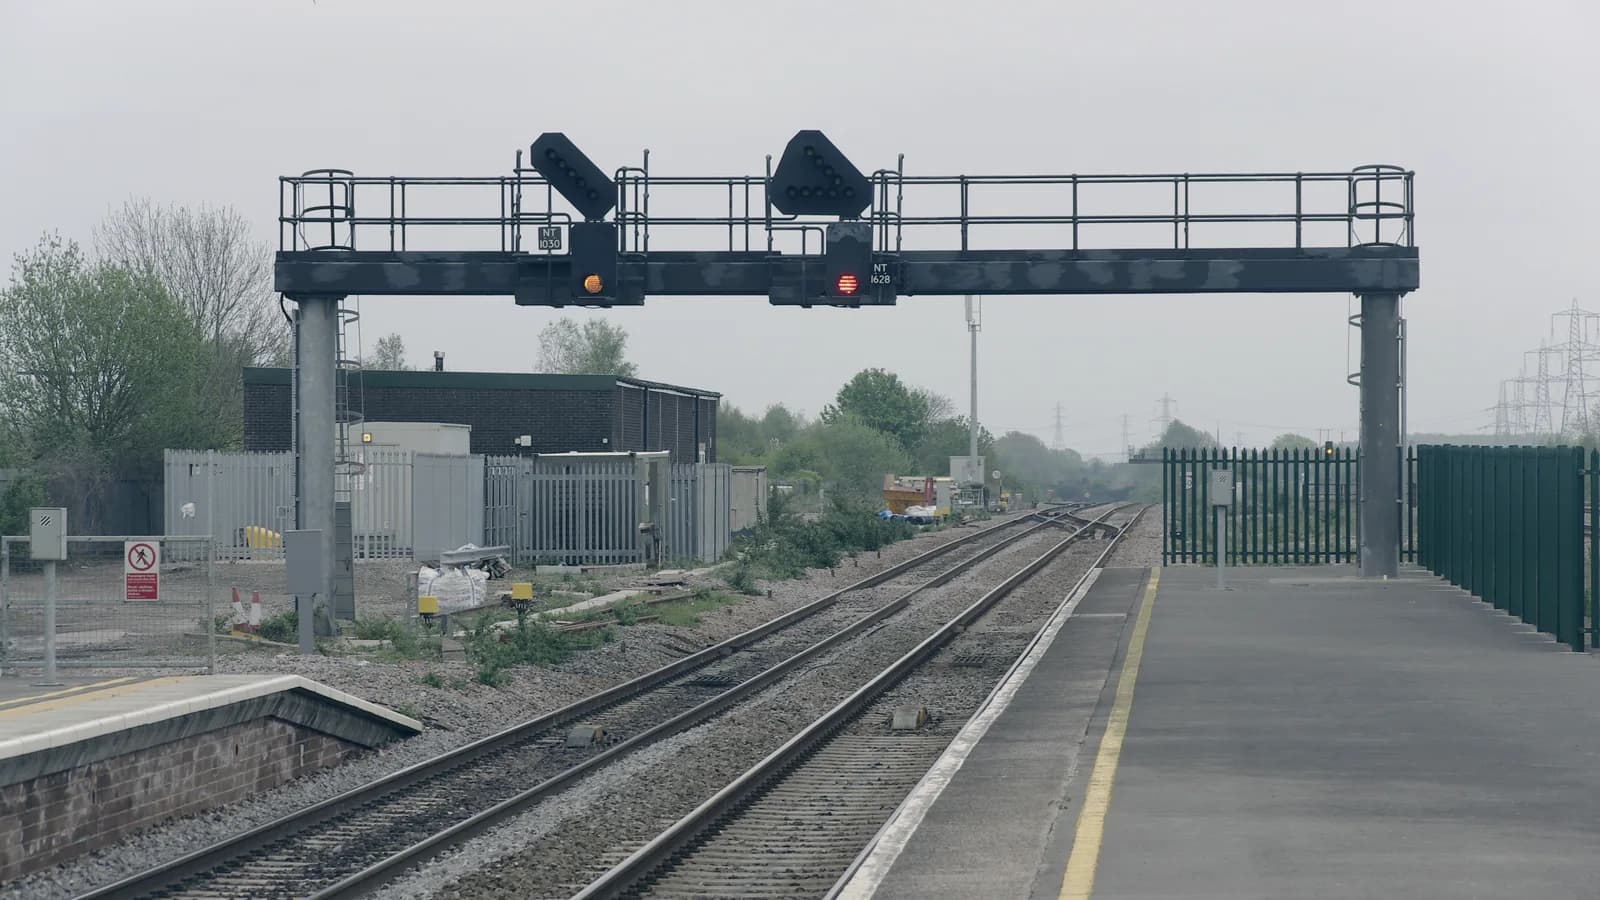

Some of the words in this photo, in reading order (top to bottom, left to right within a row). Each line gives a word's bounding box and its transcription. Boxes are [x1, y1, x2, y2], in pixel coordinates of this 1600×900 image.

[543, 228, 556, 237] NT
[540, 239, 560, 249] 1030
[874, 263, 887, 272] NT
[871, 274, 890, 284] 1628
